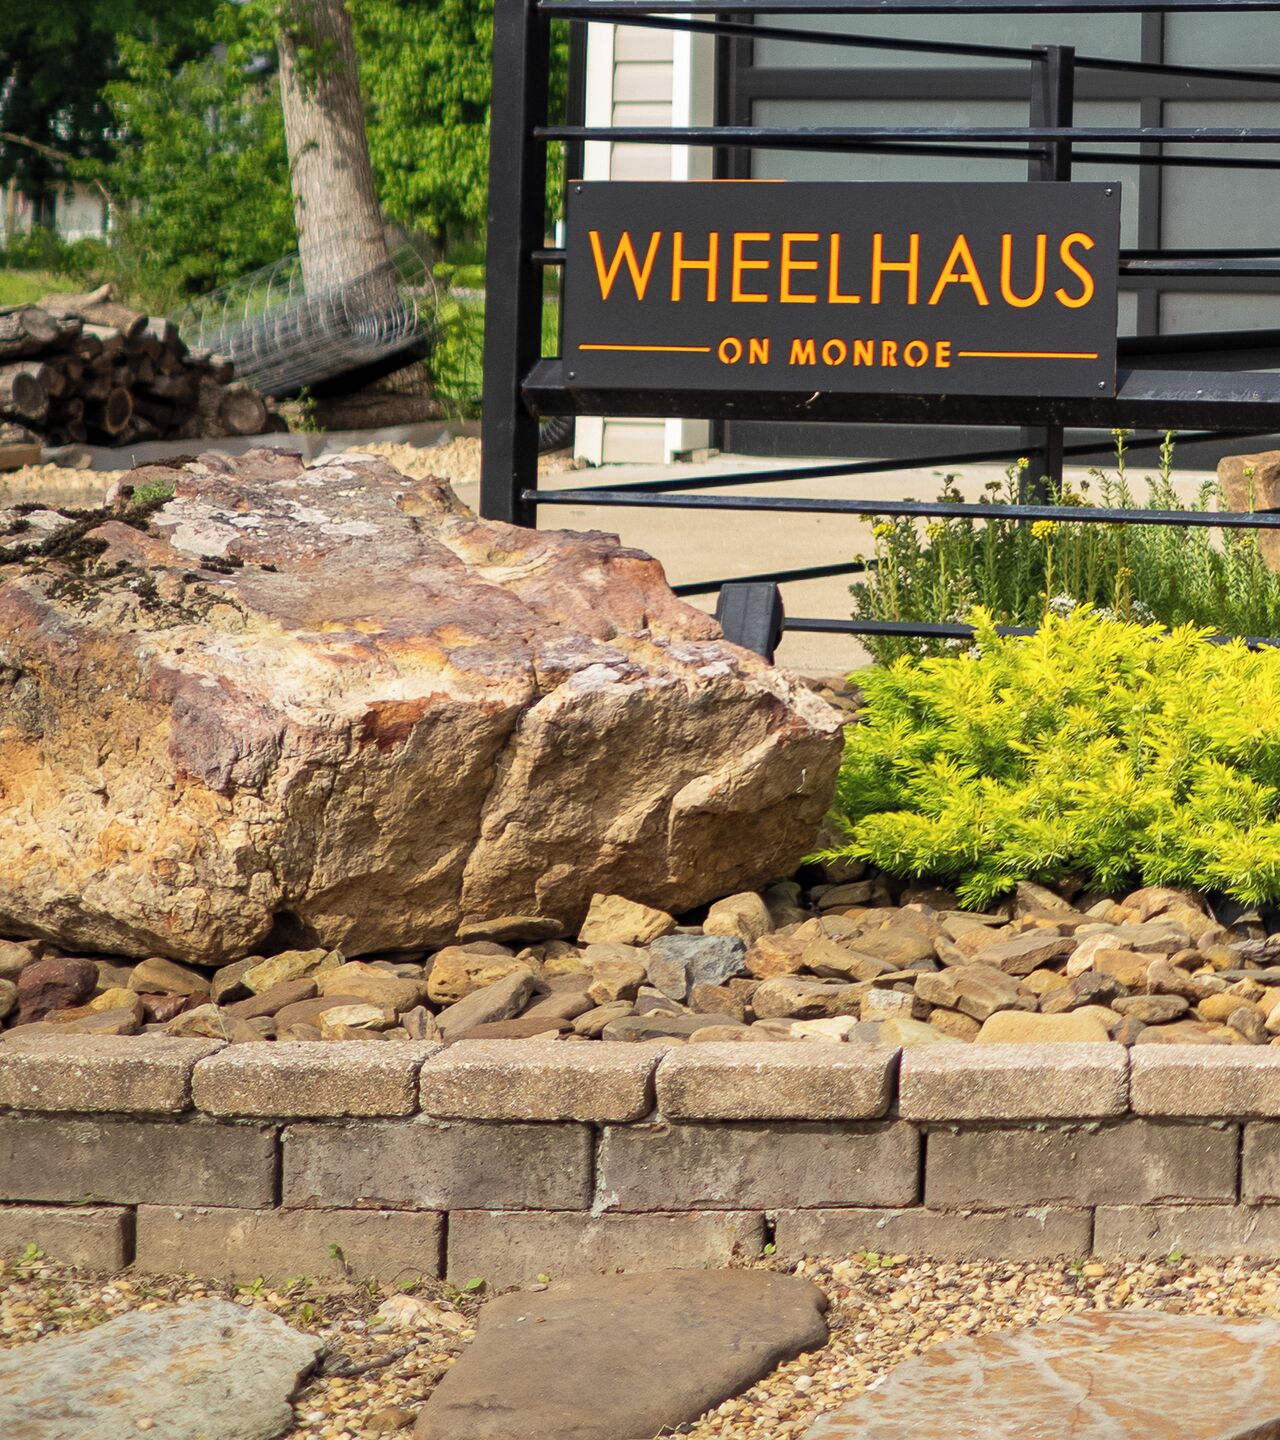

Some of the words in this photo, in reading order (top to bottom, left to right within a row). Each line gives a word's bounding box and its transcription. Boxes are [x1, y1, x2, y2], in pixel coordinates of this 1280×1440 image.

[588, 230, 1095, 308] WHEELHAUS
[717, 336, 770, 365] ON
[789, 338, 951, 368] MONROE
